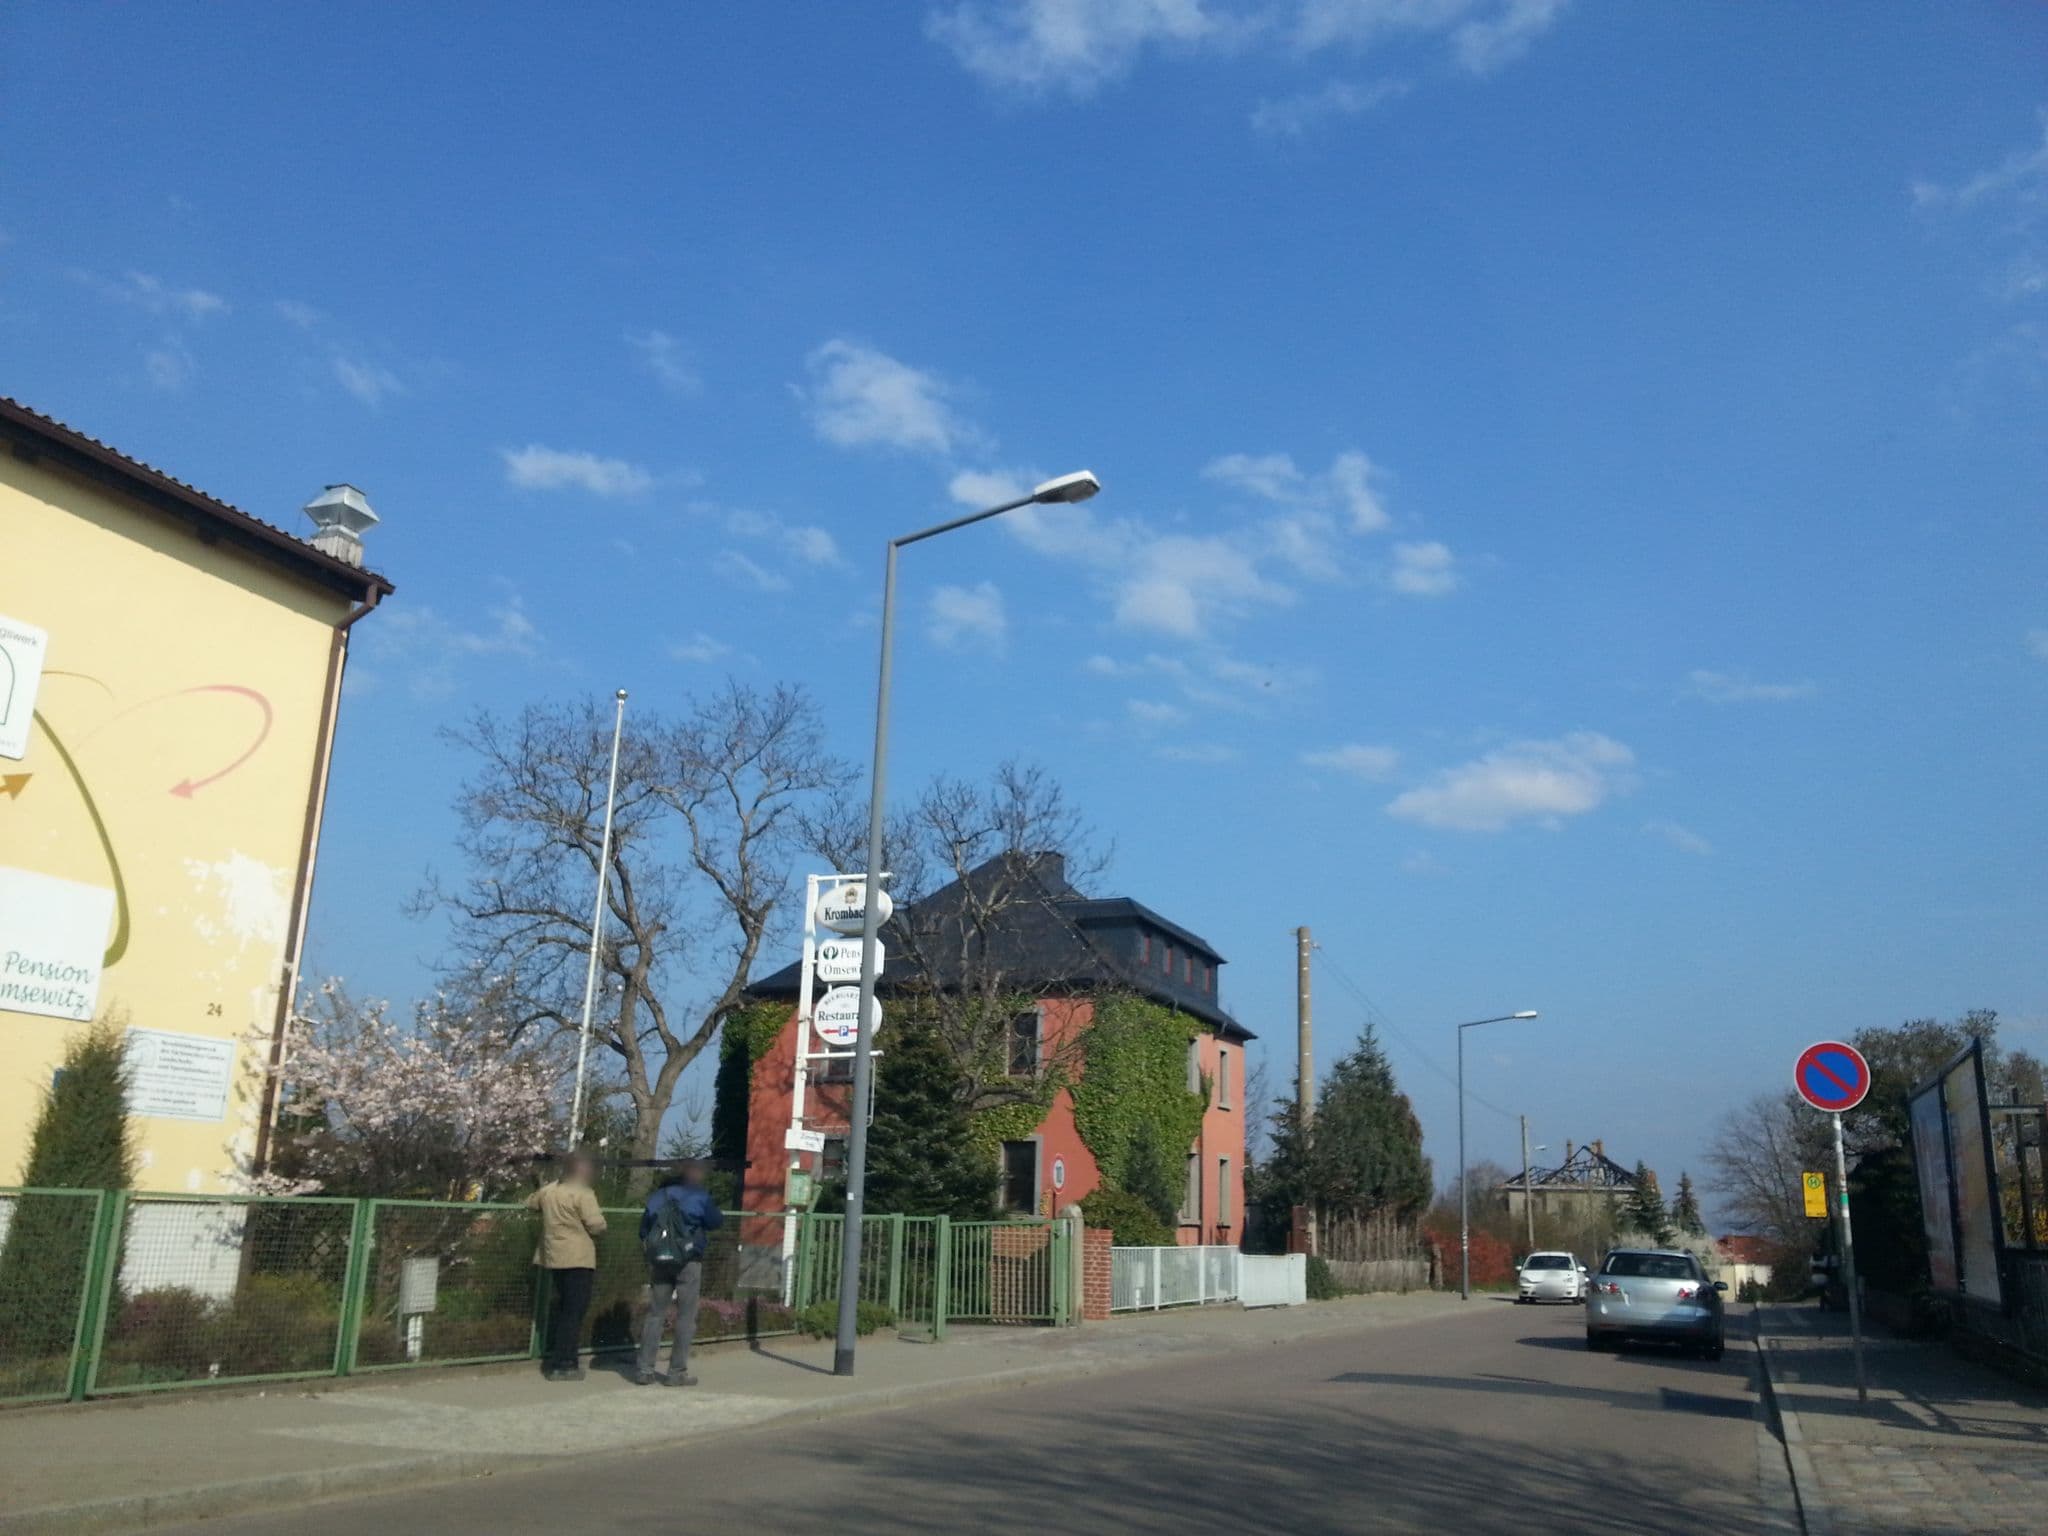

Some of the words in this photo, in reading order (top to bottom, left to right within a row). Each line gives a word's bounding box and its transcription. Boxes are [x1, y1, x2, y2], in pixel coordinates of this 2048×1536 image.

[824, 905, 865, 921] Krombac
[4, 950, 89, 985] Pension
[206, 1002, 223, 1017] 24
